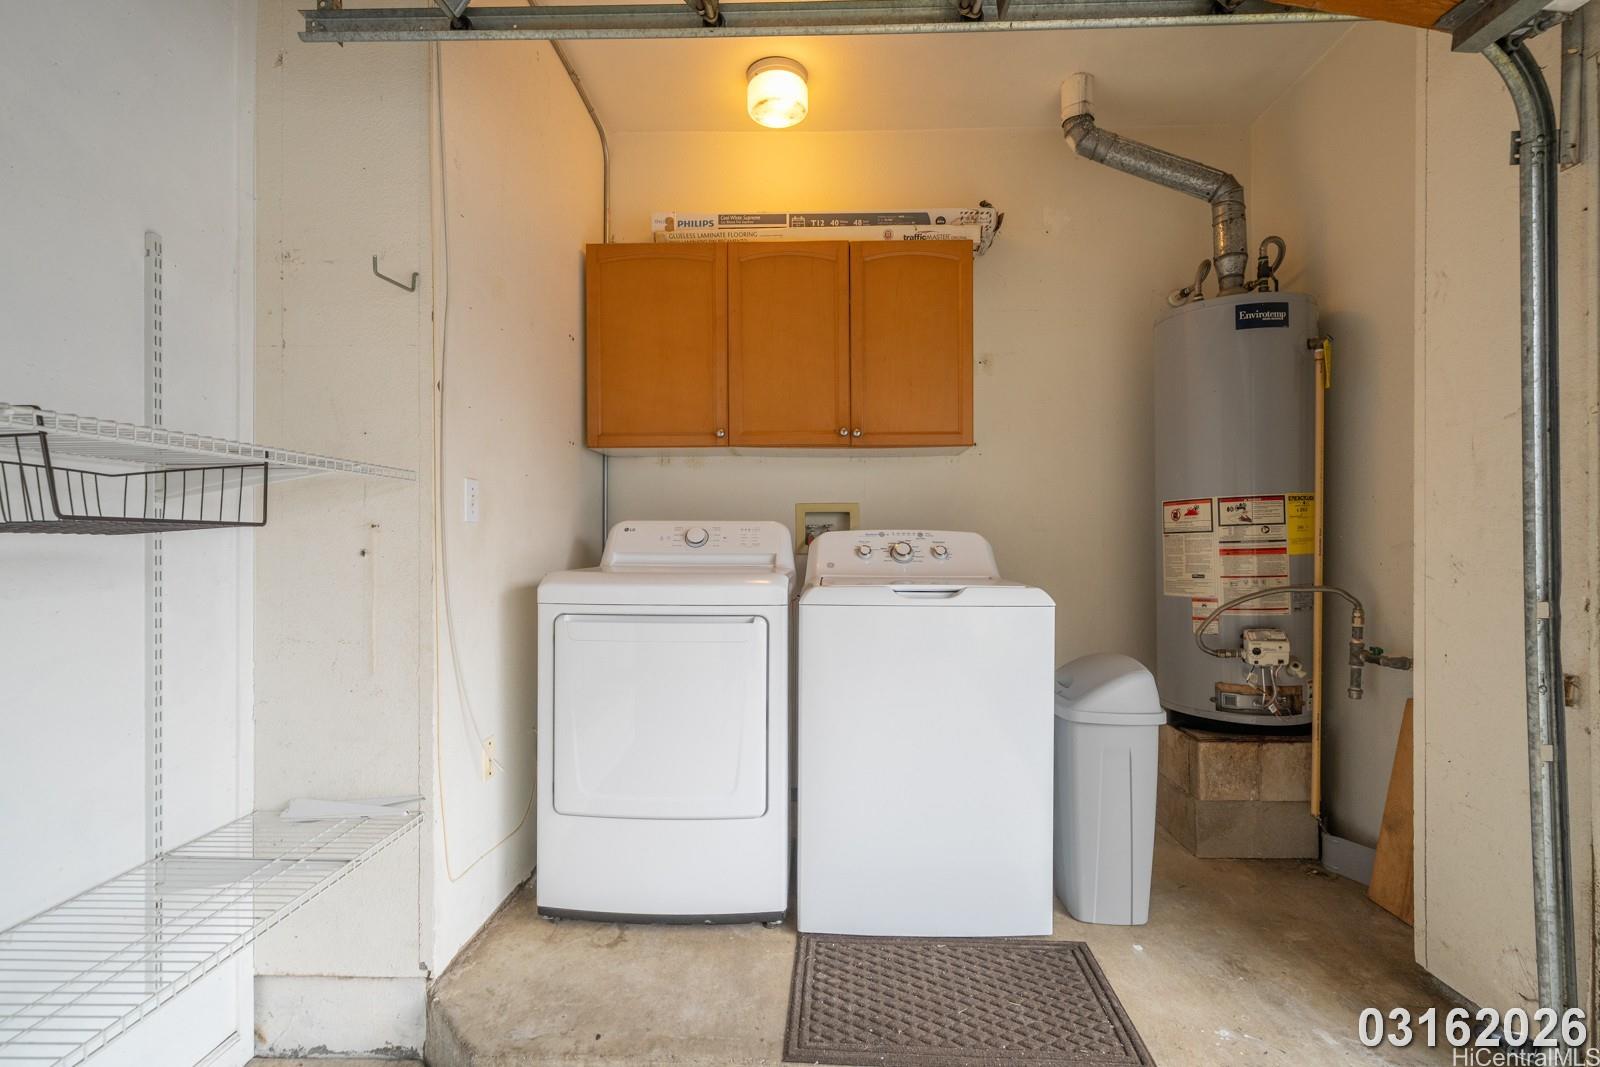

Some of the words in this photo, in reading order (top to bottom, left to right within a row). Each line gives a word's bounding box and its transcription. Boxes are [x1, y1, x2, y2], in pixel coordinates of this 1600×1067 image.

[677, 219, 714, 228] PHILIPS
[697, 231, 726, 239] LAMINATE
[1239, 309, 1287, 320] Envirotemp
